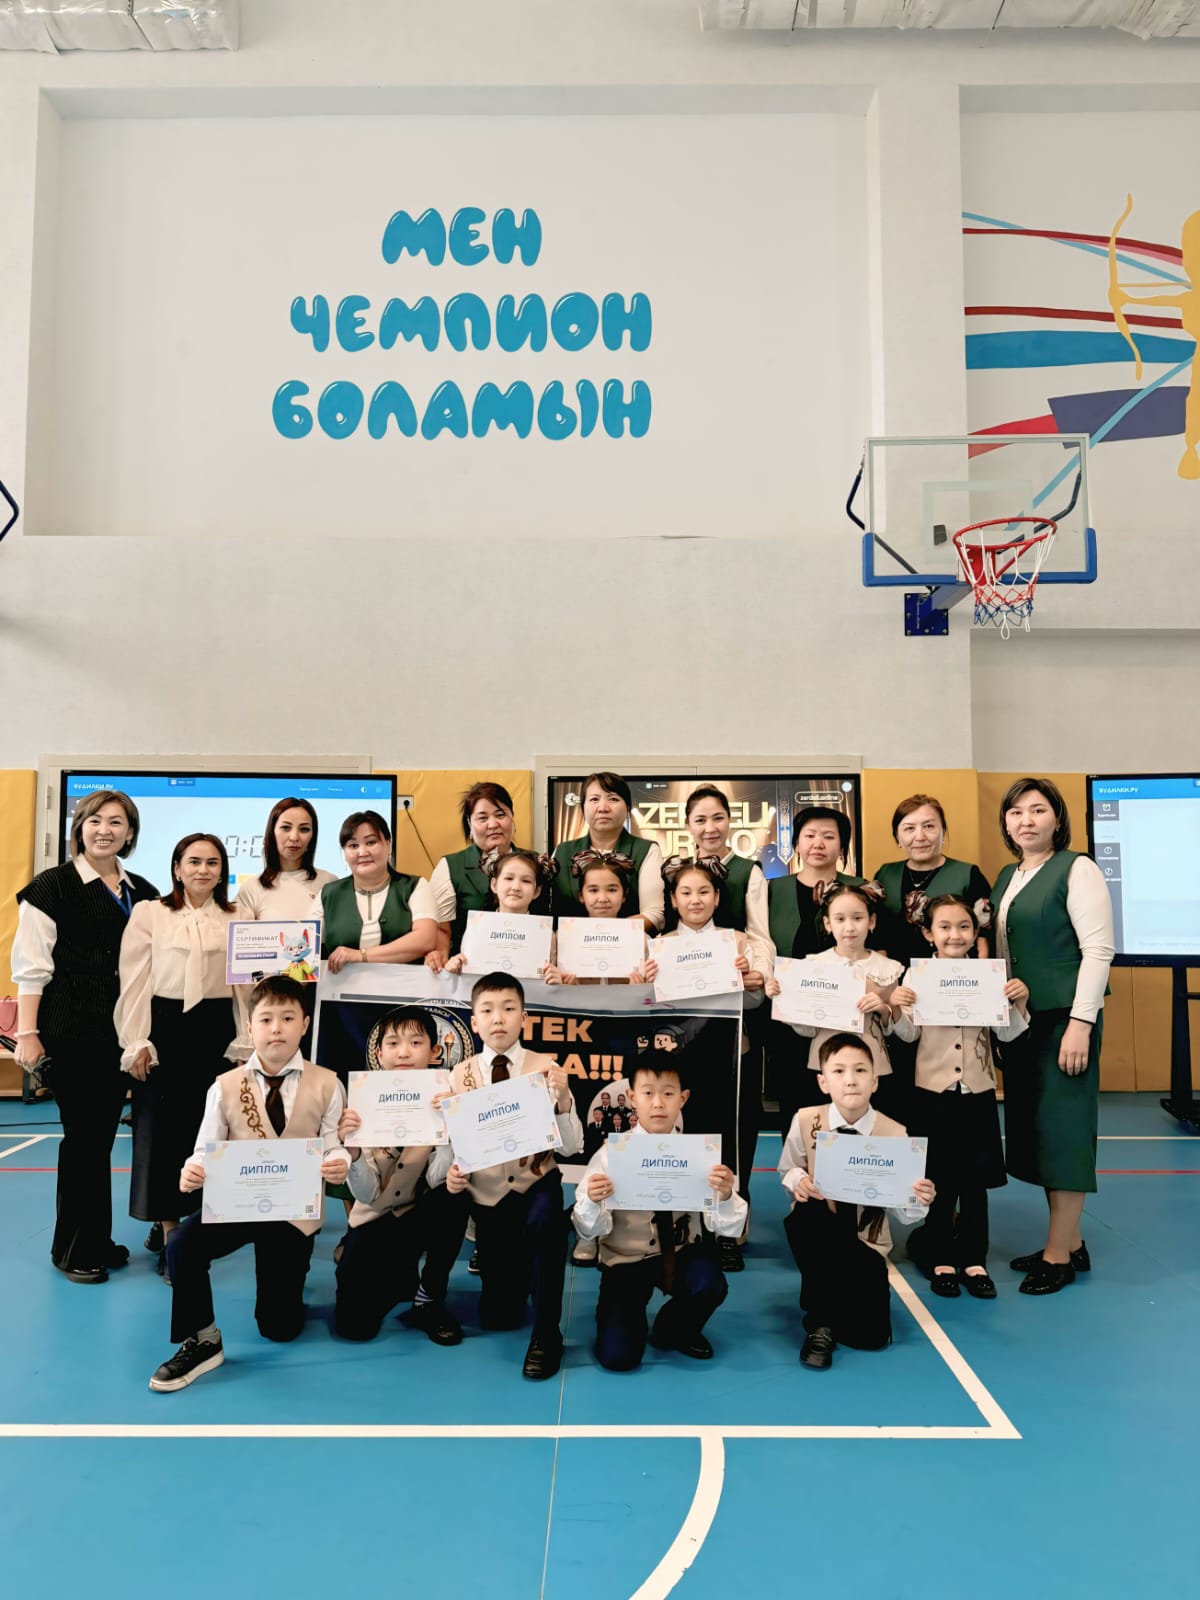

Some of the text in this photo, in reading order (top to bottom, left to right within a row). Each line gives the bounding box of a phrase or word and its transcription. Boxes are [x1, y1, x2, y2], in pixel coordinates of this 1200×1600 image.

[381, 206, 542, 267] МЕН
[290, 292, 652, 353] ЧЕМПИОН
[271, 379, 652, 441] БОЛАМЫН
[490, 931, 526, 941] ДИПЛОМ
[583, 934, 619, 943] ДИПЛОМ
[676, 951, 713, 963] ДИПЛОМ
[800, 979, 839, 991] ДИПЛОМ
[940, 979, 979, 988] ДИПЛОМ
[378, 1093, 421, 1103] ДИПЛОМ
[478, 1101, 521, 1123] ДИПЛОМ
[641, 1158, 688, 1169] ДИПЛОМ
[847, 1156, 895, 1168] ДИПЛОМ
[239, 1164, 288, 1176] ДИПЛОМ
